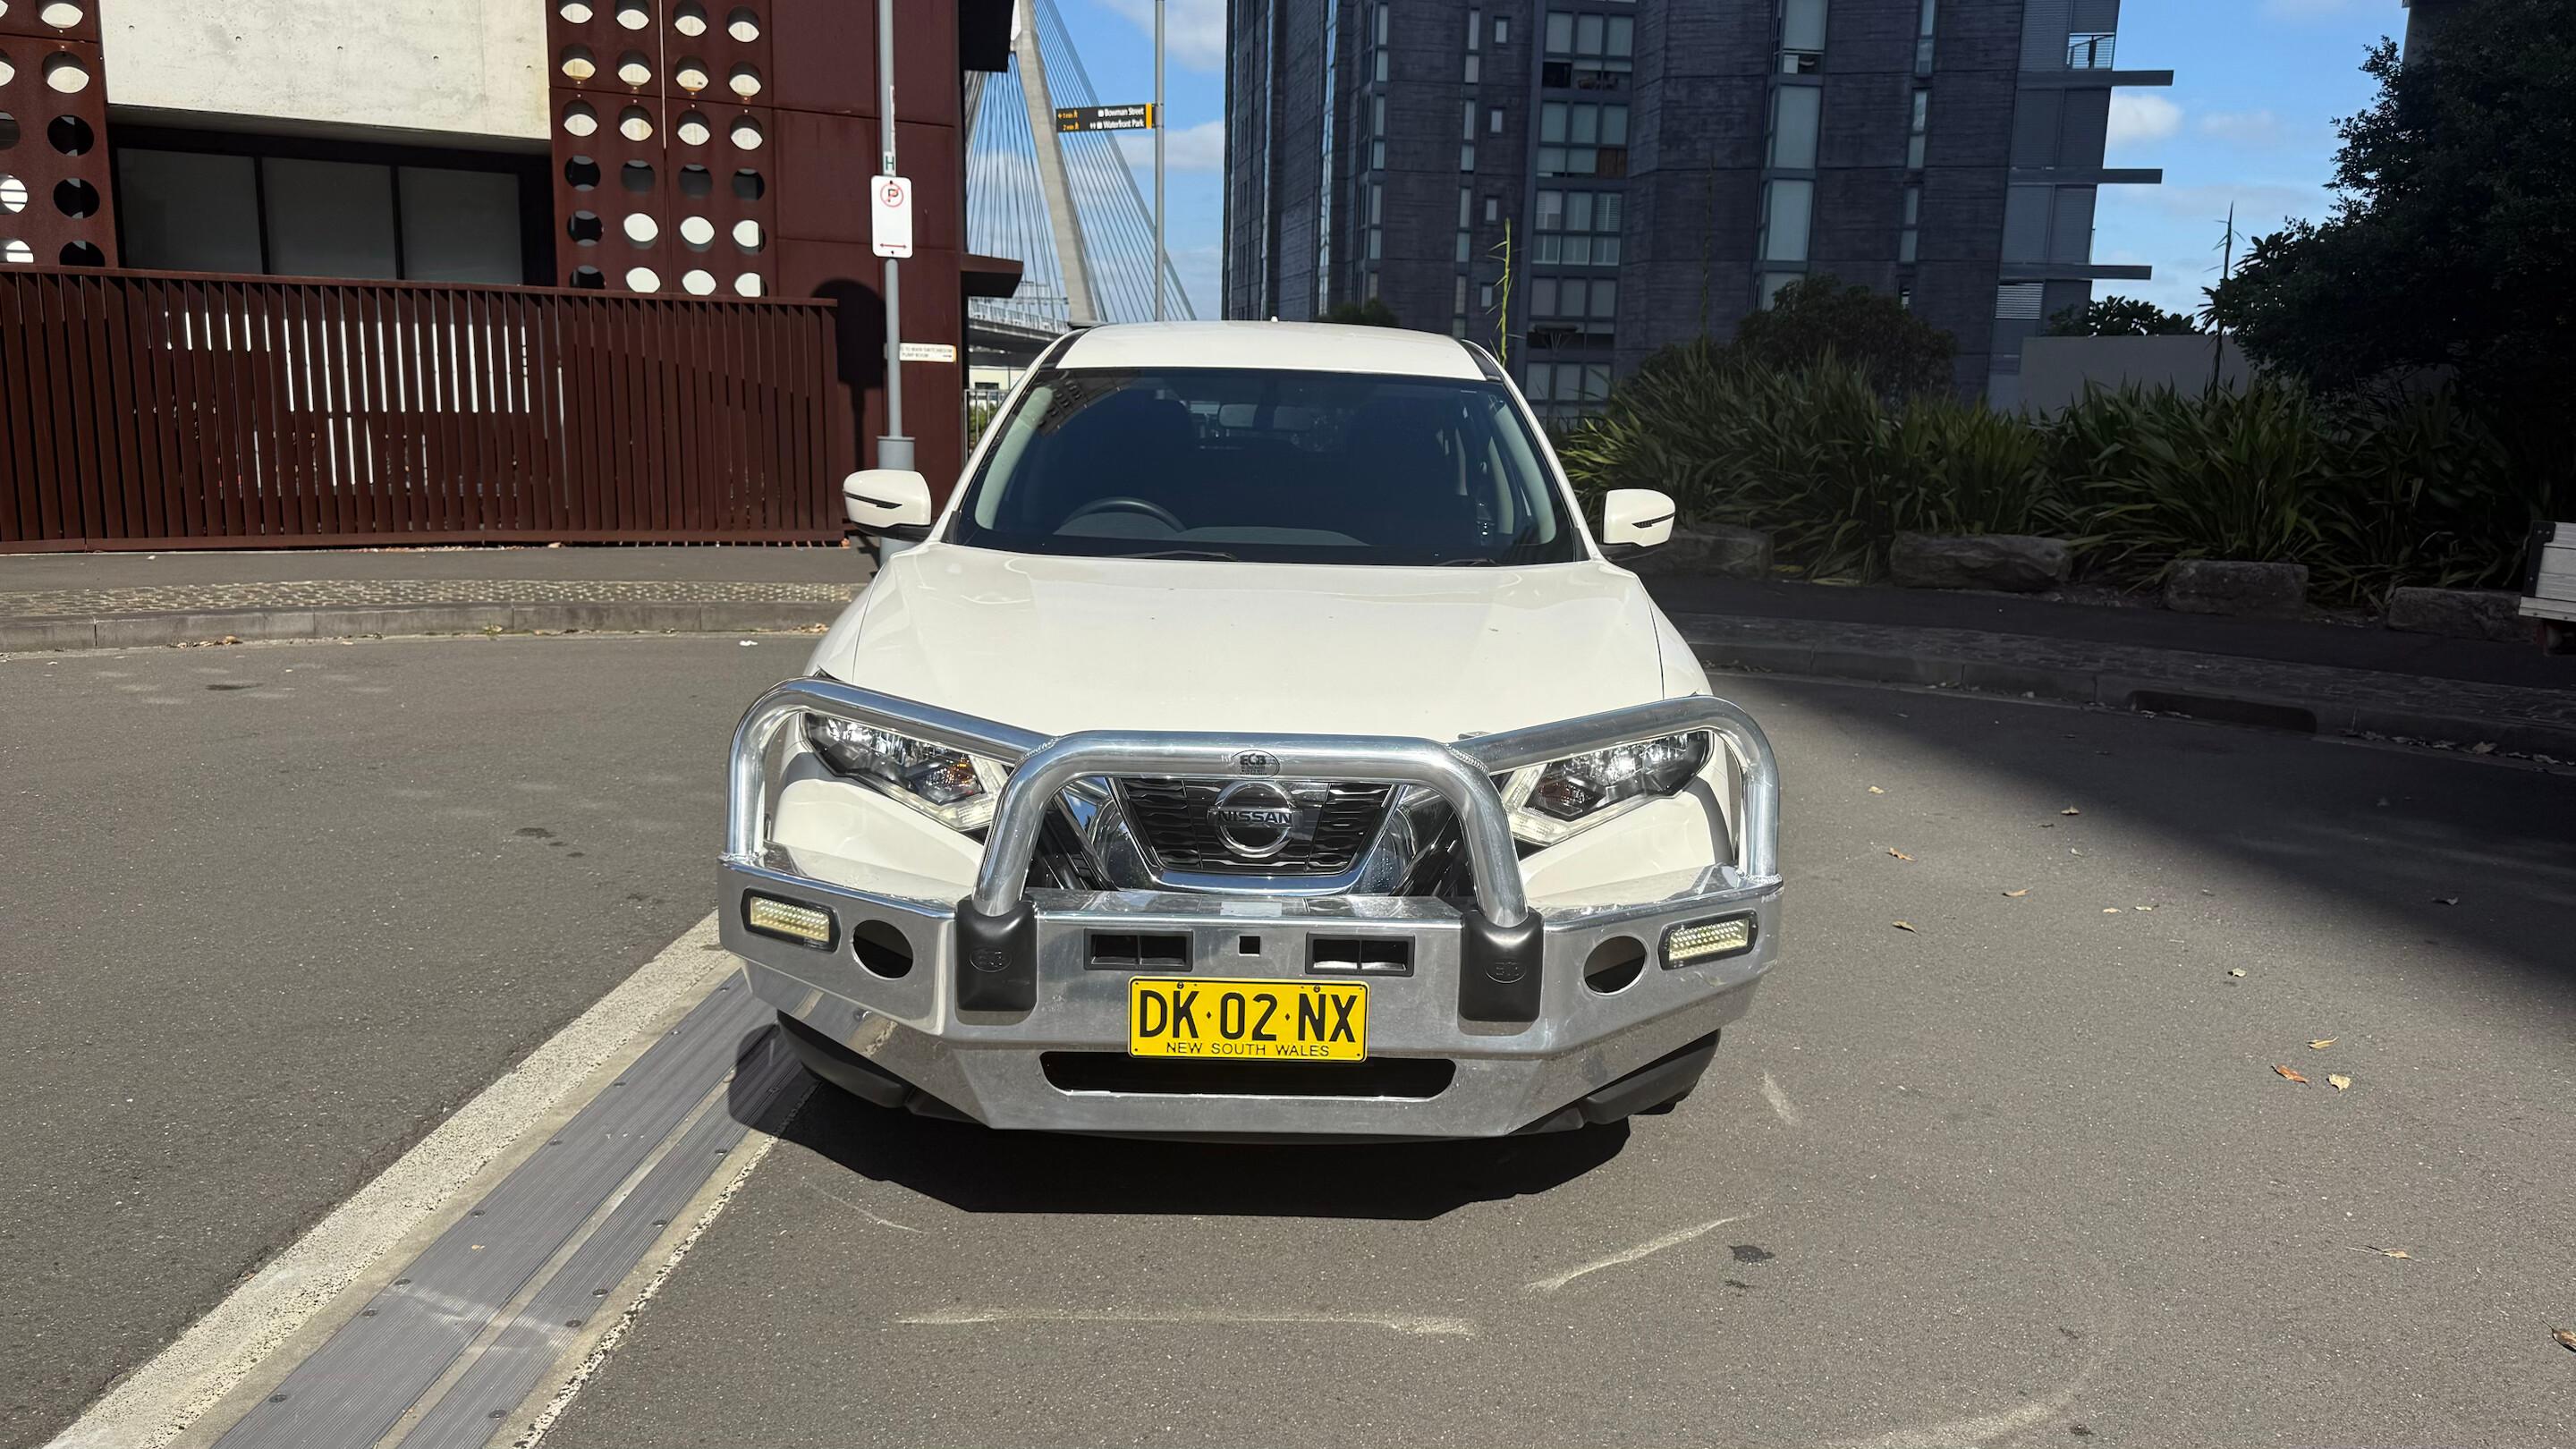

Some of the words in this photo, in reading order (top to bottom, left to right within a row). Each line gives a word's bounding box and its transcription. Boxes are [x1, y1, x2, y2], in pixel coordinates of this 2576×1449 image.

[1105, 108, 1127, 117] Bowman
[1128, 107, 1144, 116] Street
[1103, 119, 1131, 129] Waterfront
[1131, 119, 1144, 127] Park
[886, 156, 894, 170] H
[887, 189, 899, 202] P
[1218, 811, 1292, 824] NISSAN
[1166, 1042, 1202, 1054] NEW
[1211, 1043, 1266, 1055] SOUTH
[1275, 1045, 1330, 1056] WALES
